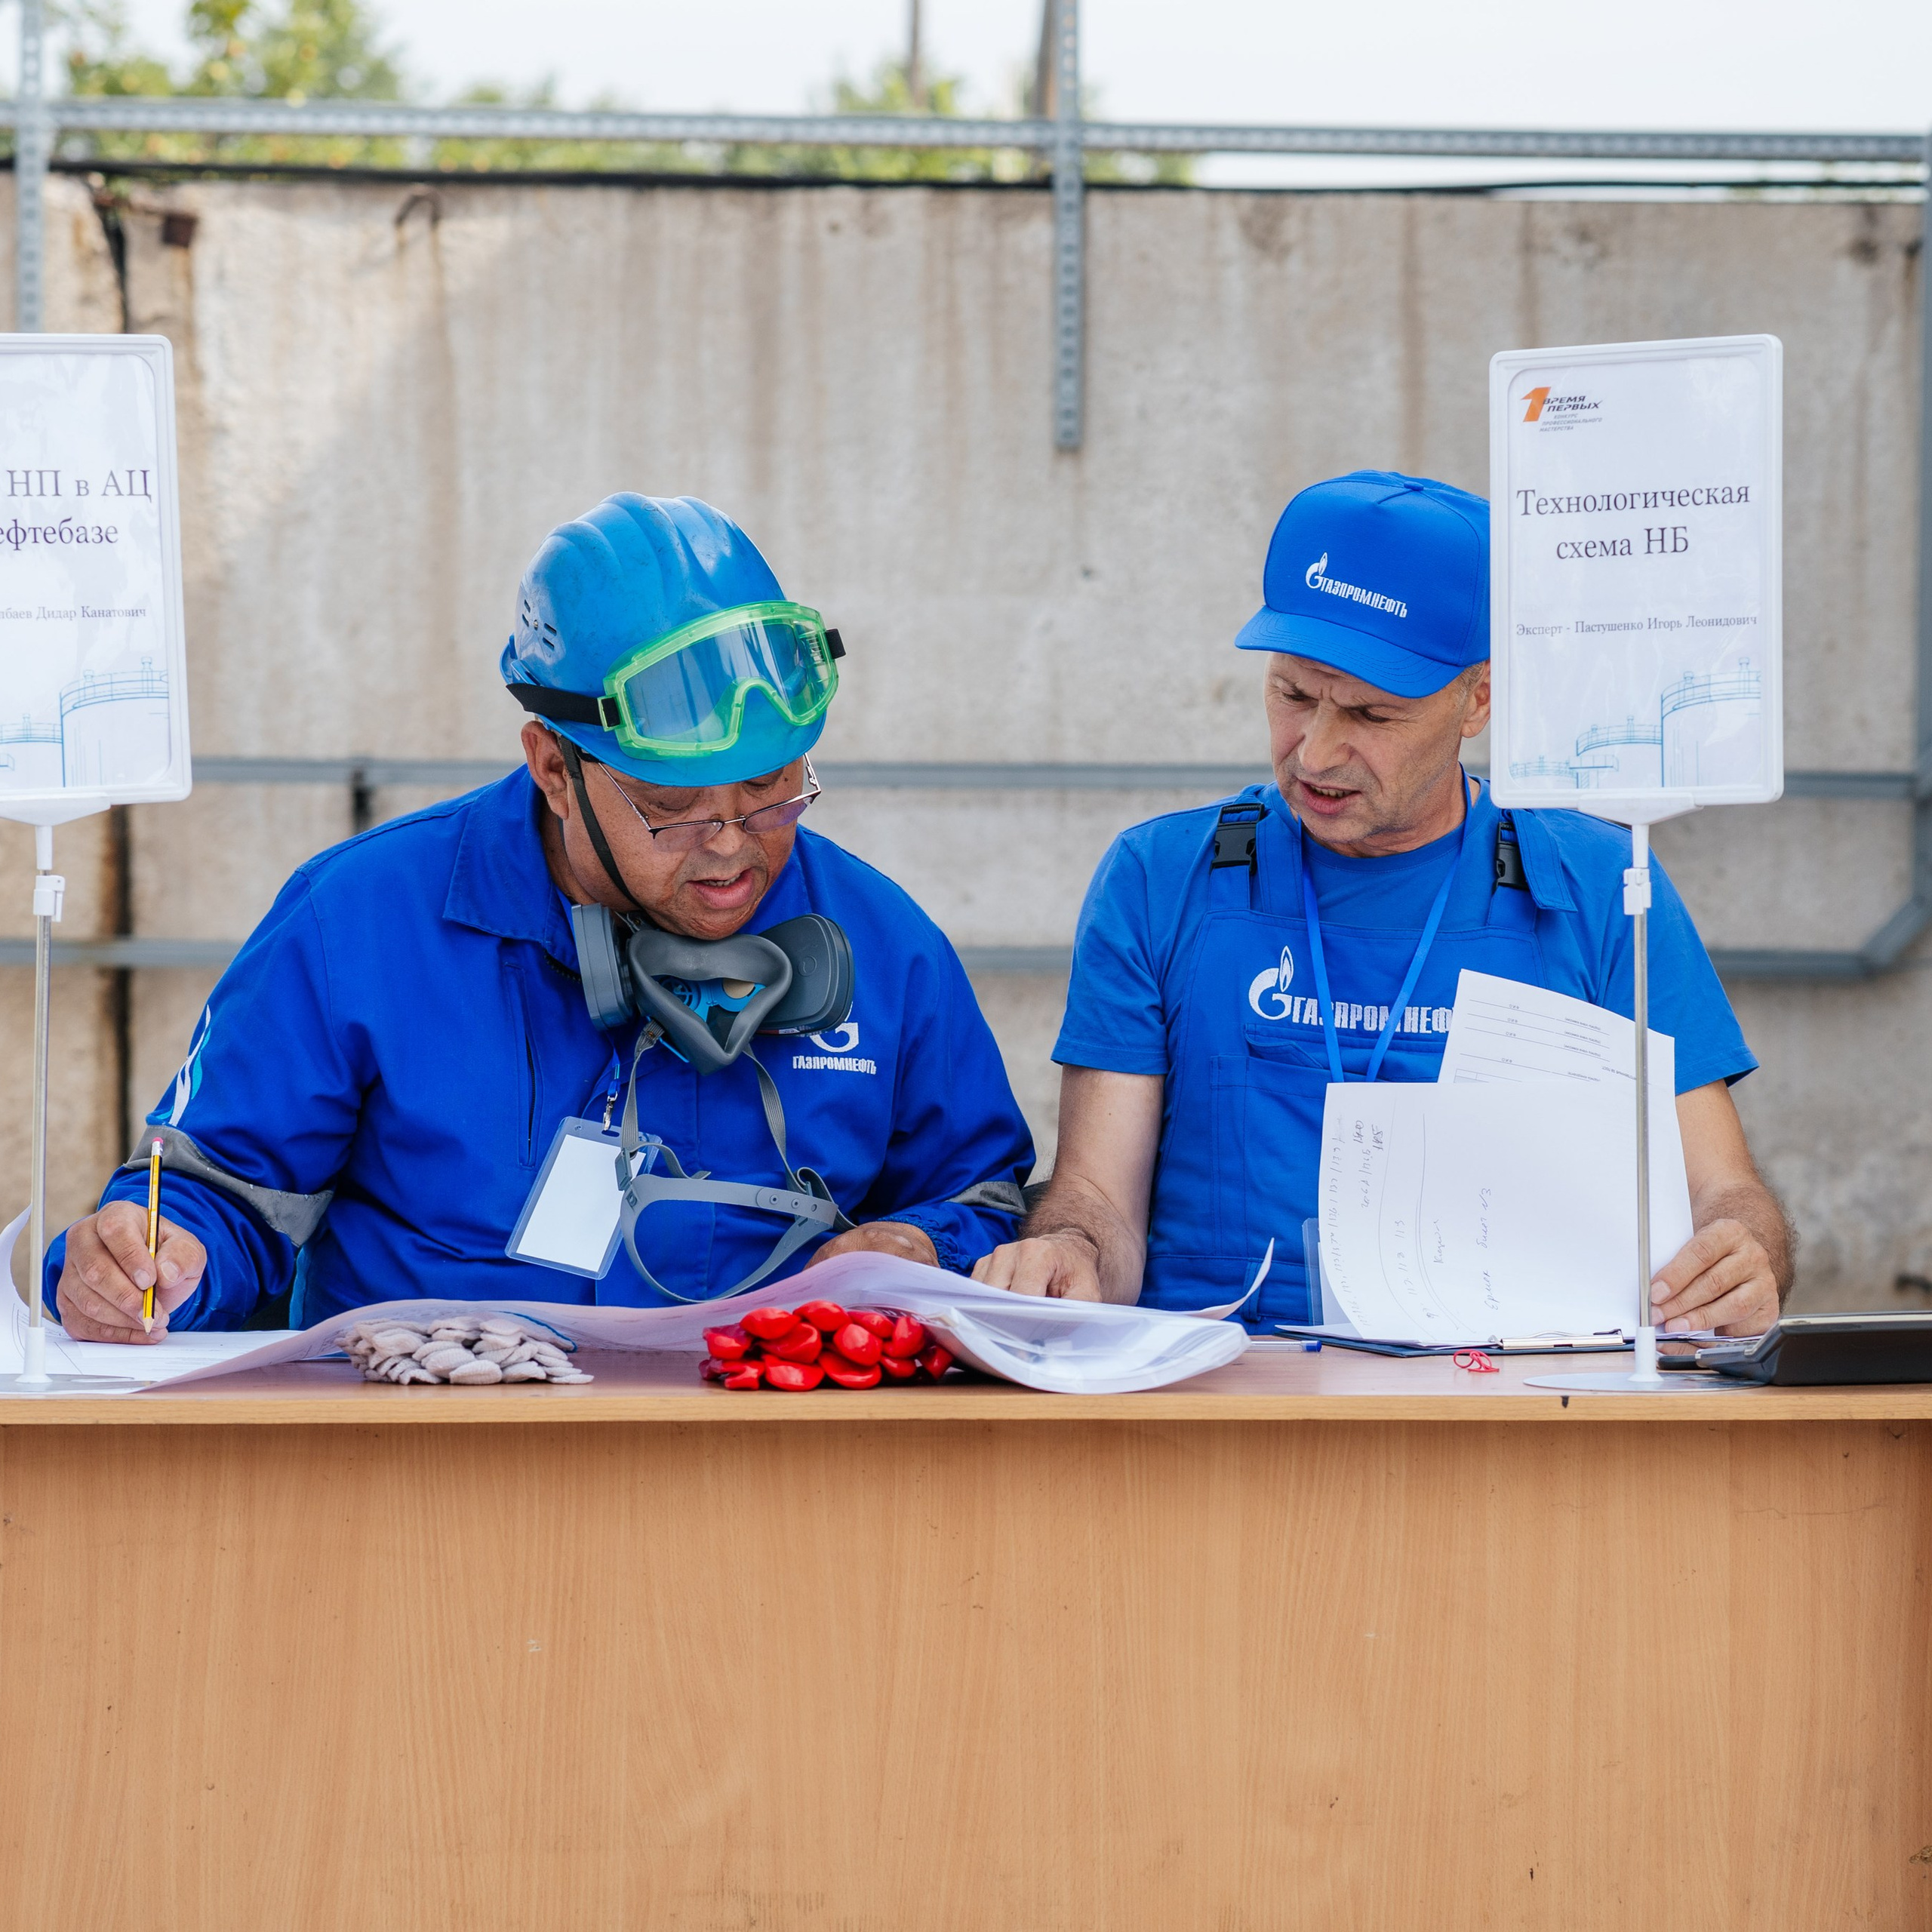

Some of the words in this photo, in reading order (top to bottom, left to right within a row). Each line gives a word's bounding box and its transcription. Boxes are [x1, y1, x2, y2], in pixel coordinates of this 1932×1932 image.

[1543, 395, 1586, 405] ВРЕМЯ
[1547, 400, 1603, 412] ПЕРВЫХ
[6, 469, 62, 497] НП
[75, 478, 90, 497] в
[101, 469, 152, 503] АЦ
[1516, 485, 1751, 516] Технологическая
[1555, 537, 1633, 559] схема
[1644, 525, 1689, 555] НБ
[1320, 575, 1408, 618] ГАЗПРОМНЕФТЬ
[36, 605, 76, 621] Дидар
[81, 605, 146, 618] Канатович
[1516, 623, 1563, 637] Эксперт
[1575, 620, 1644, 635] Пастушенко
[1647, 617, 1682, 631] Игорь
[1686, 615, 1758, 629] Леонидович
[1291, 995, 1454, 1034] ГАПРОНЕФ
[792, 1055, 877, 1075] ГАЗПРОМНЕФТЬ
